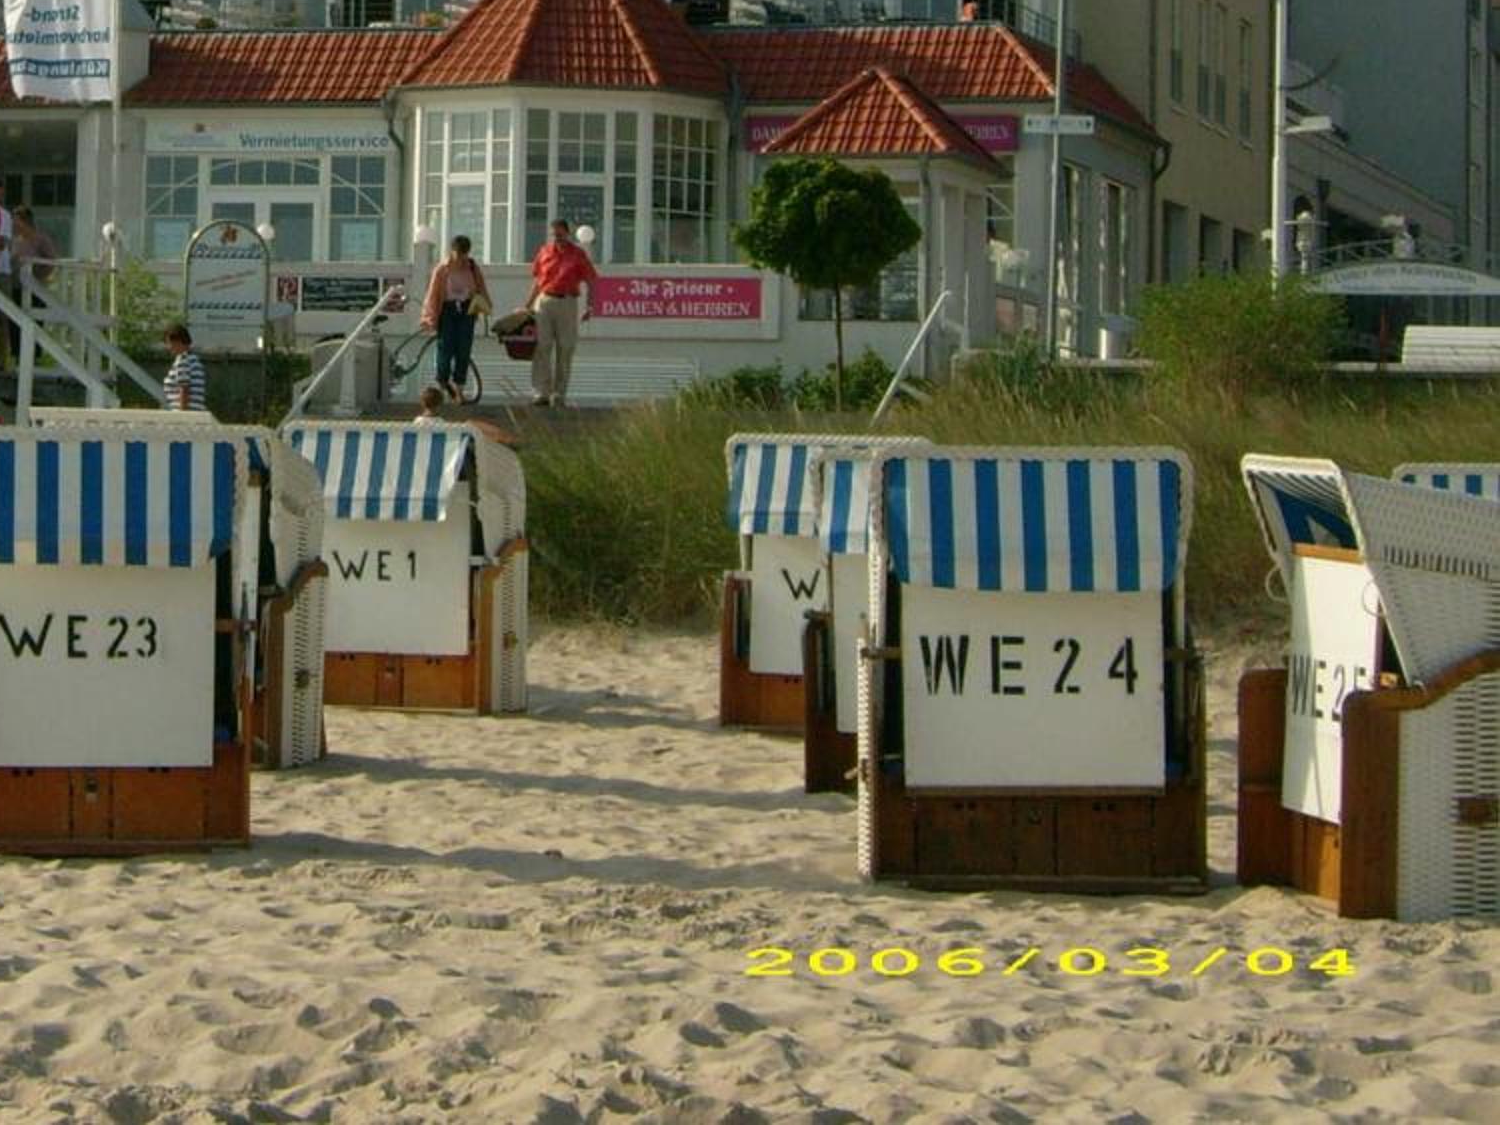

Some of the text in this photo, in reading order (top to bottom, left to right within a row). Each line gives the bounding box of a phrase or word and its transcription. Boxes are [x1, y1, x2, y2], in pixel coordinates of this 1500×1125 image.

[239, 132, 389, 149] Vermietungsservice
[602, 300, 751, 316] DAMEN & HERREN
